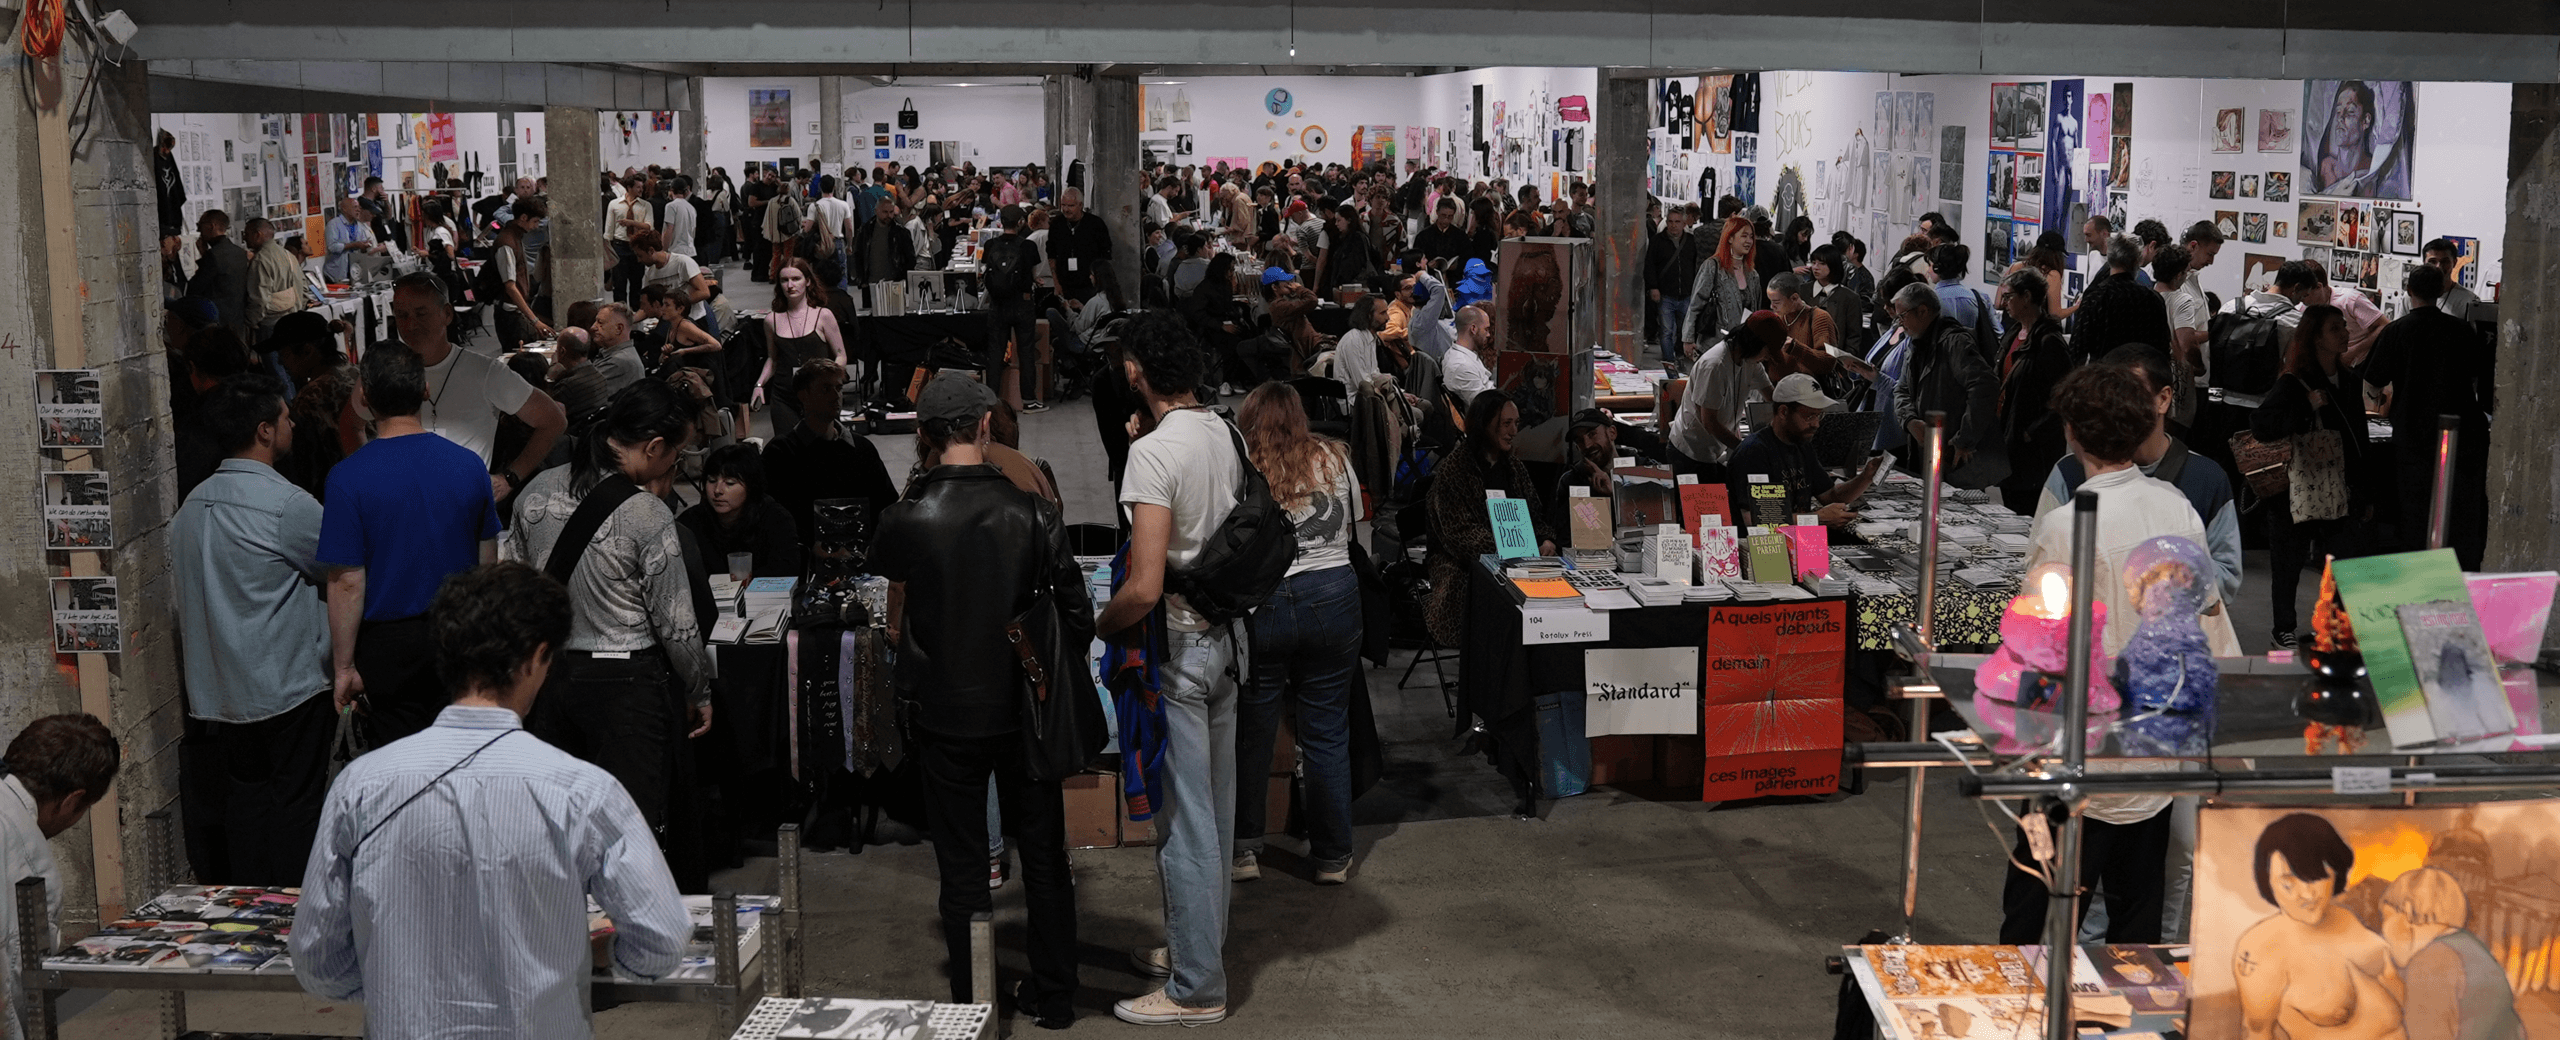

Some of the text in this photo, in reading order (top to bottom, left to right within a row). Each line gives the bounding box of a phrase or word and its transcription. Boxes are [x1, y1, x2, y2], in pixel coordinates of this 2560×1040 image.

[1775, 110, 1812, 160] BOOKS
[0, 332, 21, 359] 4
[48, 507, 57, 515] We
[1493, 500, 1521, 525] quitté
[1498, 525, 1526, 548] Paris
[1751, 536, 1759, 546] LE
[1756, 545, 1781, 554] PARFAIT
[1712, 607, 1830, 627] A quels vivants
[1775, 620, 1841, 636] debouts
[1711, 655, 1771, 671] demain
[1709, 766, 1797, 783] ces images
[1754, 774, 1836, 794] parleront?
